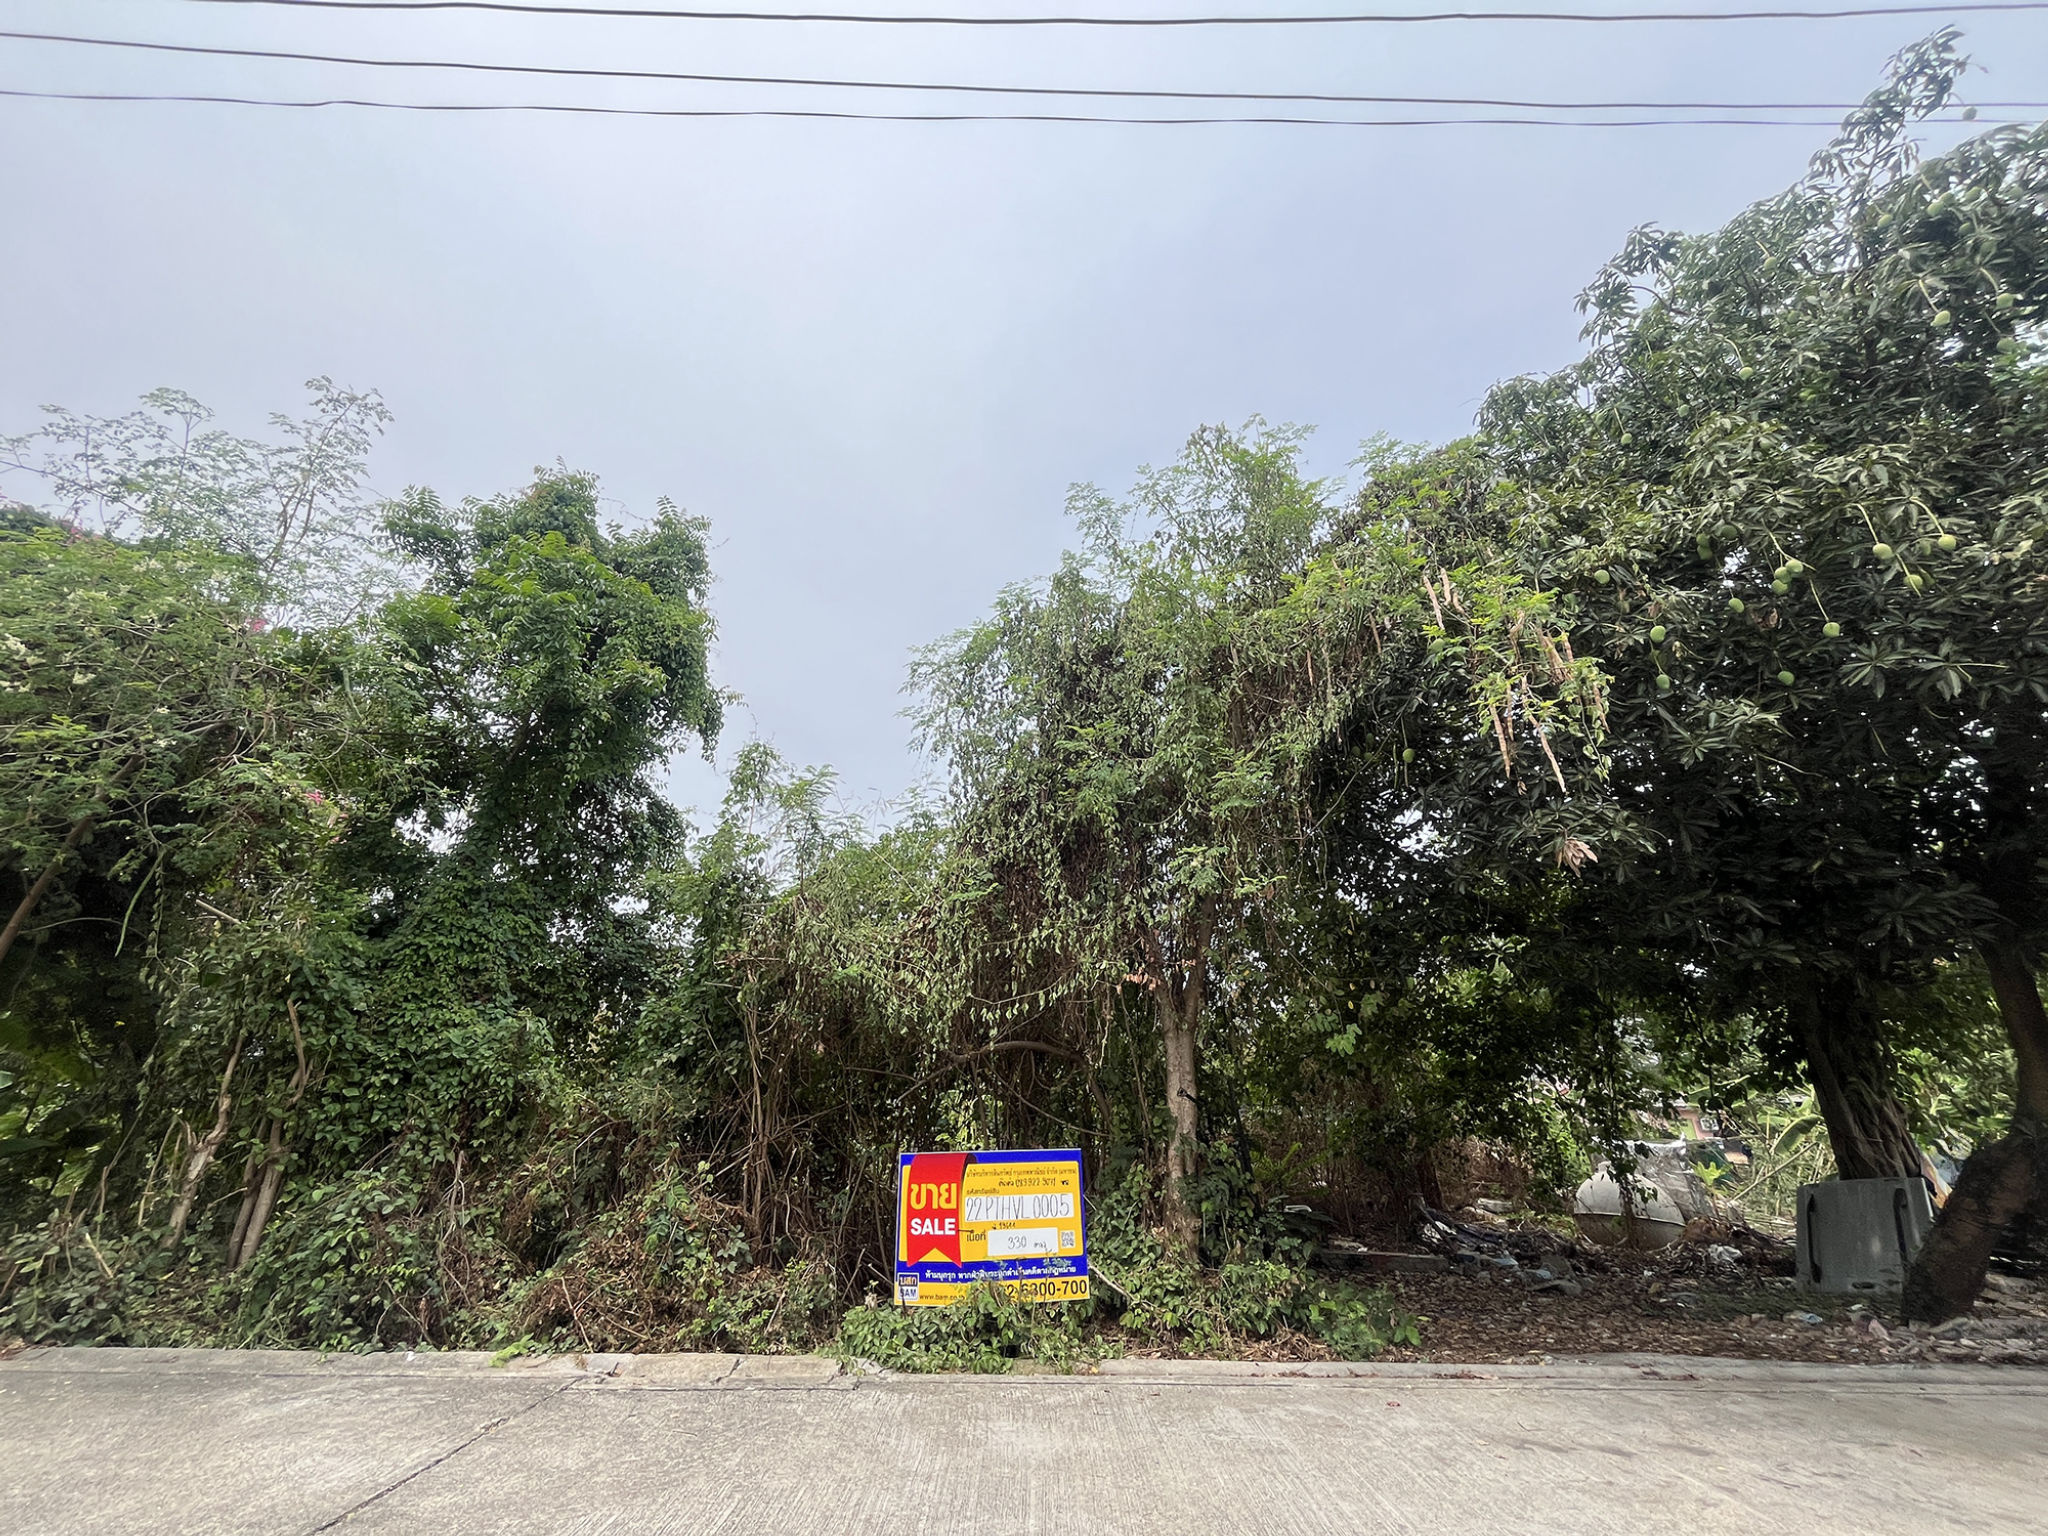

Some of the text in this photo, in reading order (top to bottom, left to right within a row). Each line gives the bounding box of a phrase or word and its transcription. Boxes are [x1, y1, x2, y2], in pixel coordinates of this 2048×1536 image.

[911, 1183, 957, 1209] ขาย
[911, 1217, 956, 1236] SALE
[1007, 1235, 1028, 1250] 330
